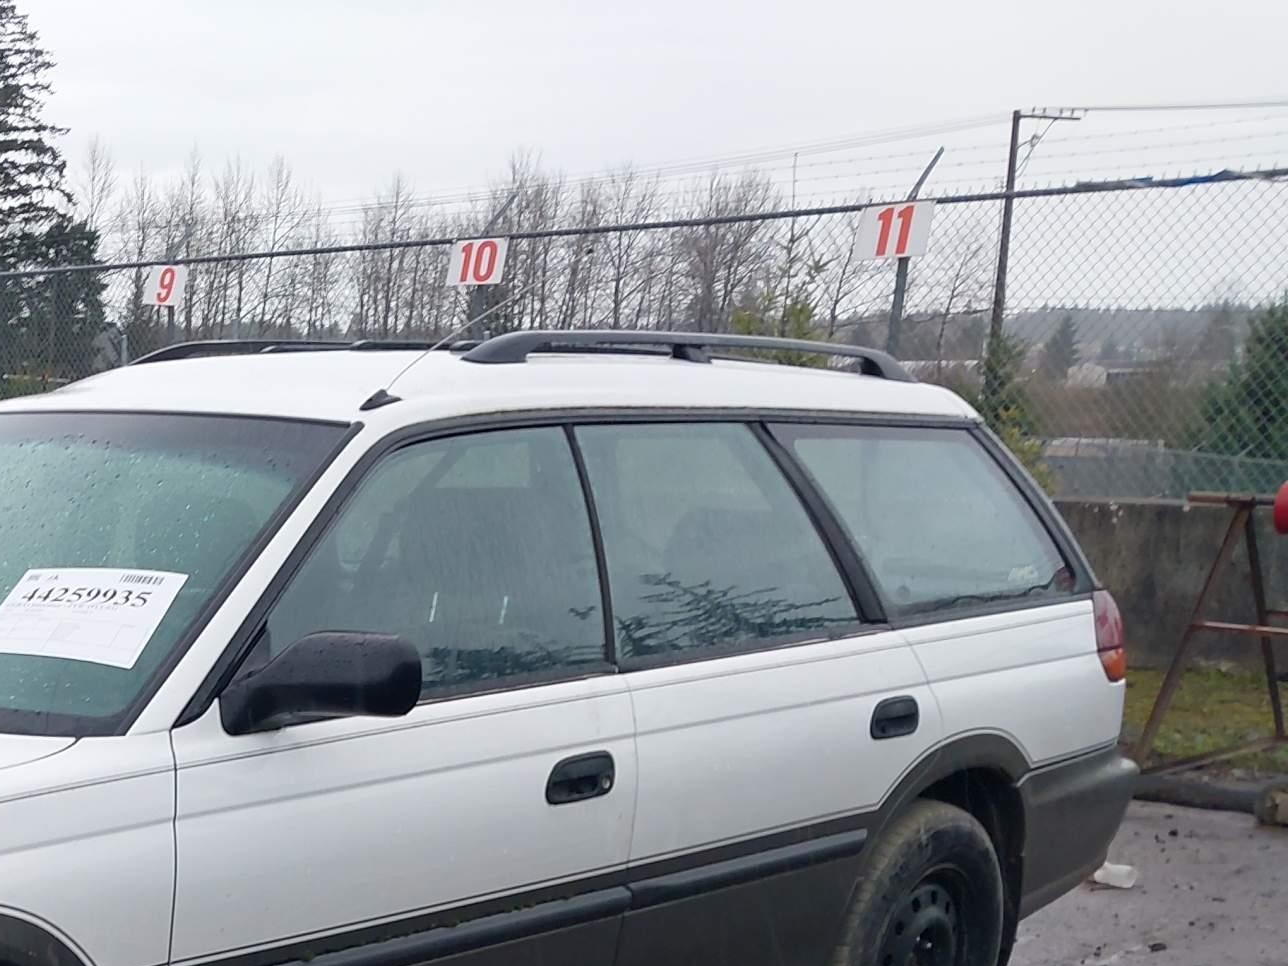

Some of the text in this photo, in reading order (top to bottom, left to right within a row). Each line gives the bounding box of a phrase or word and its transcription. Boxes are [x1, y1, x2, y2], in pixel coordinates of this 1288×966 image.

[876, 204, 915, 257] 11
[459, 239, 499, 284] 10
[156, 266, 177, 306] 9
[21, 585, 153, 608] 44259935
